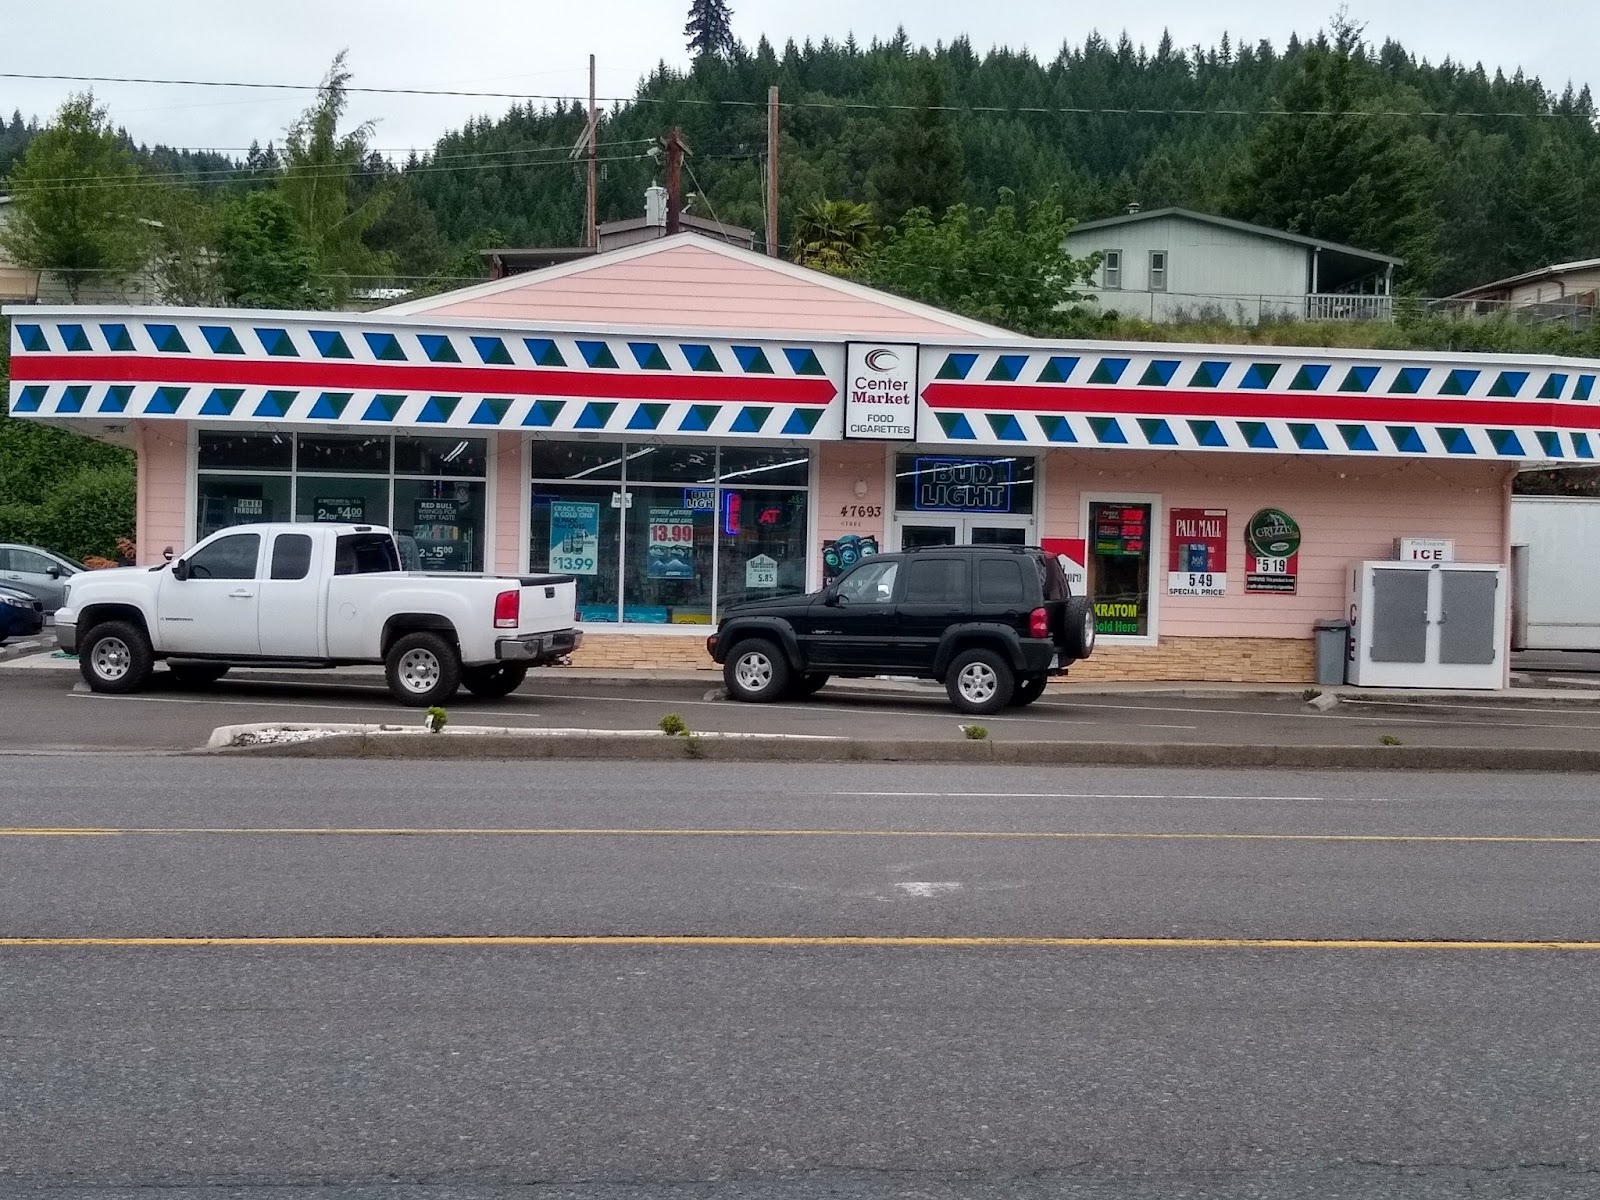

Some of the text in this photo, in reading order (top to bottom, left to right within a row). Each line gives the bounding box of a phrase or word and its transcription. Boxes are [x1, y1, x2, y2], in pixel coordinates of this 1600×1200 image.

[855, 376, 908, 390] Center
[852, 392, 910, 404] Market
[868, 414, 894, 422] FOOD
[850, 424, 910, 434] CIGARETTES
[933, 463, 994, 485] BUD
[921, 485, 1005, 507] LIGHT
[686, 499, 714, 508] LIGH
[318, 509, 326, 520] 2
[651, 525, 692, 542] 13.99
[1176, 520, 1221, 537] PALL MALL
[1256, 525, 1294, 537] GRIZZLY
[420, 549, 426, 558] 2
[1412, 550, 1443, 560] ICE
[553, 557, 594, 570] $13.99
[1094, 604, 1136, 617] KRATOM
[1116, 622, 1136, 632] Here
